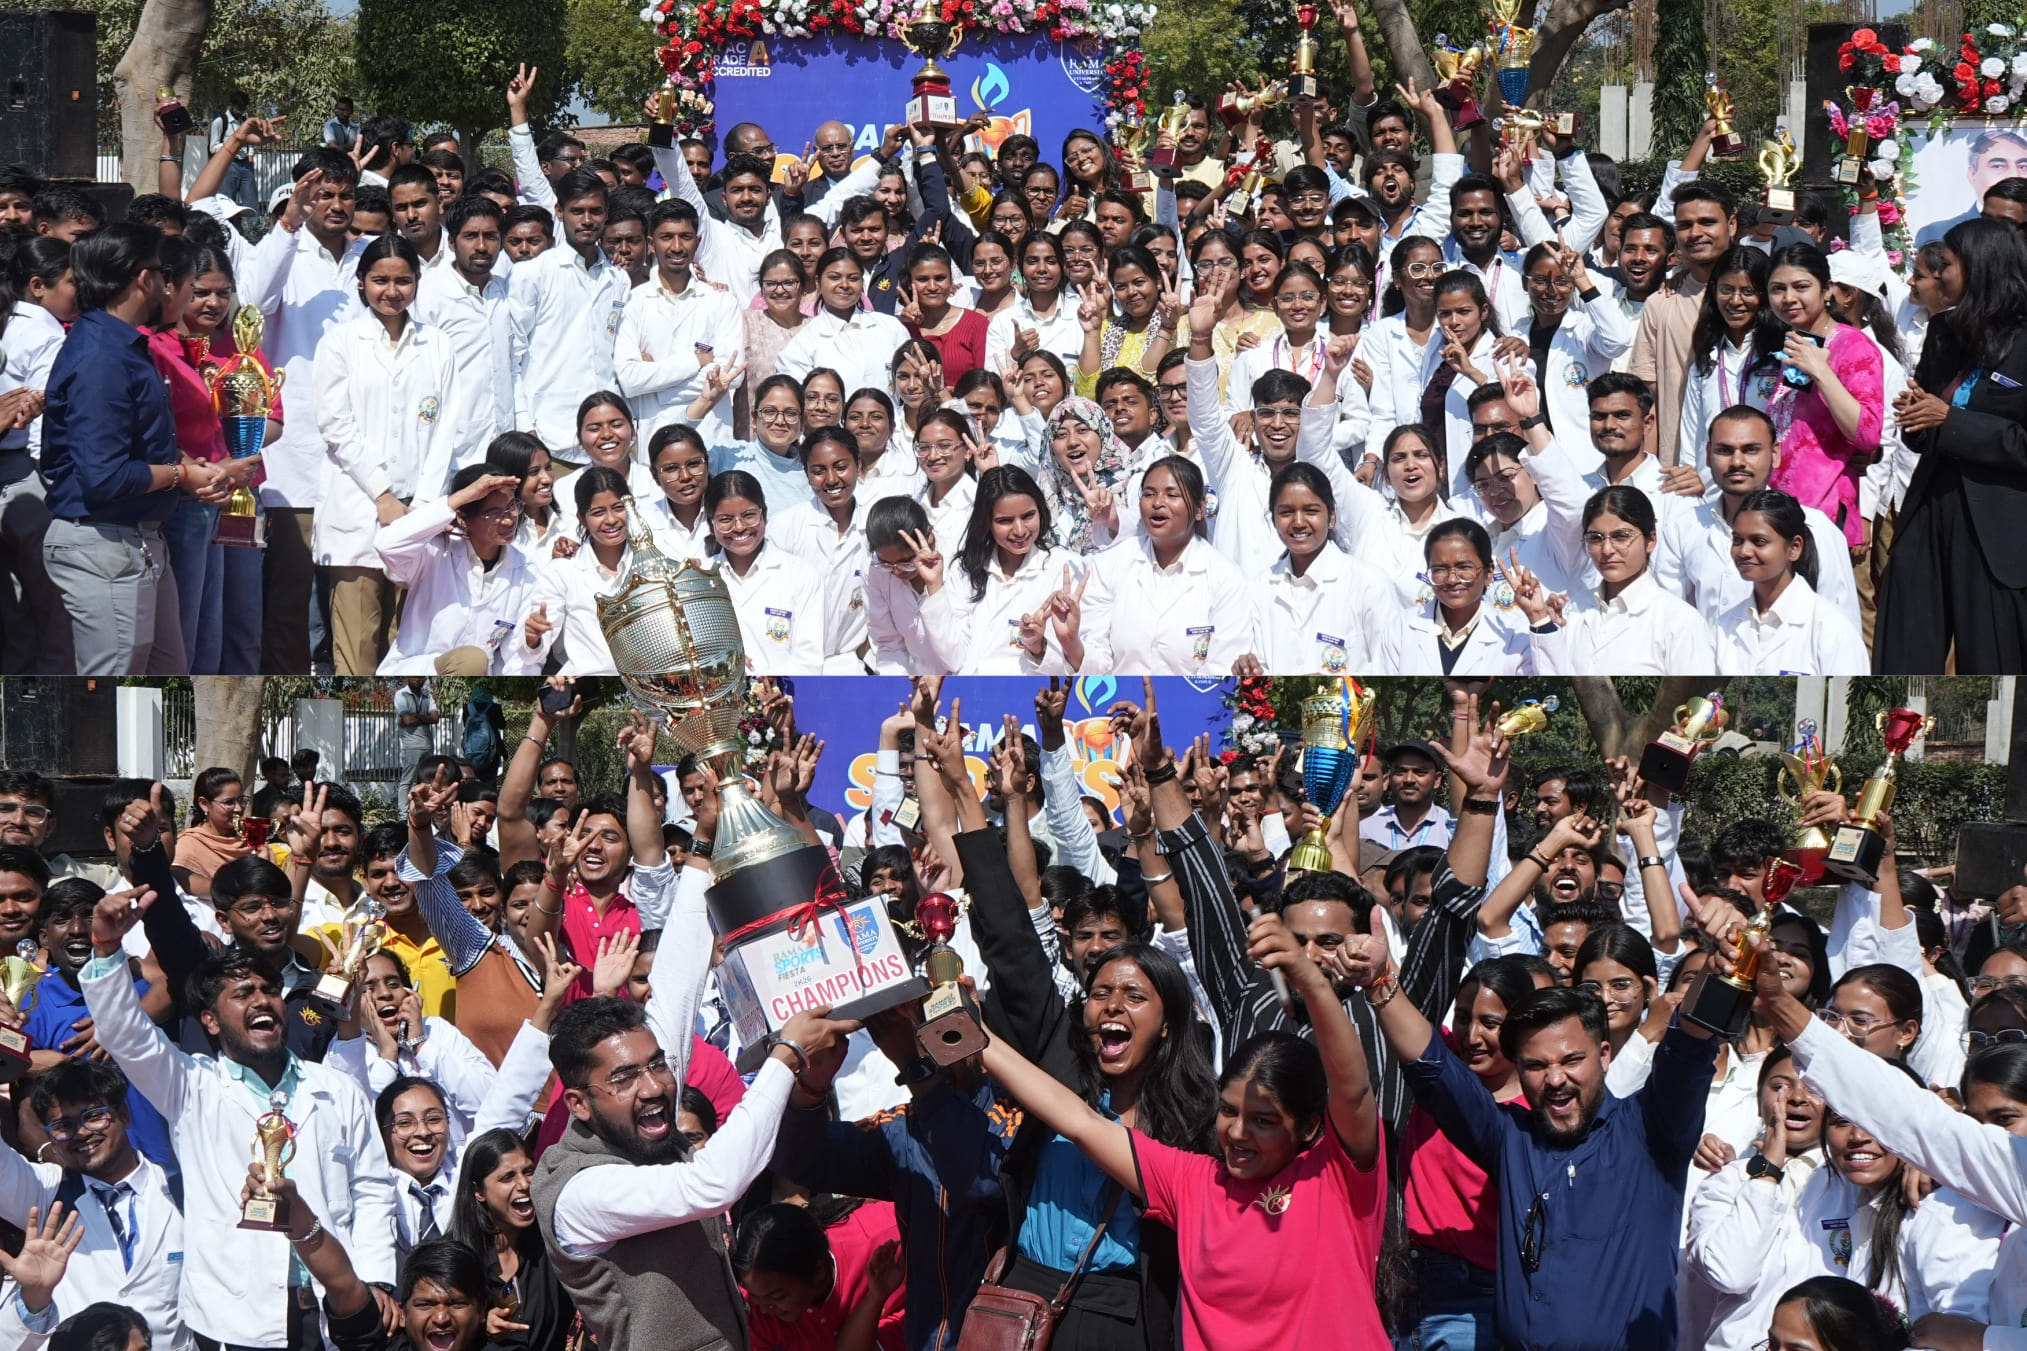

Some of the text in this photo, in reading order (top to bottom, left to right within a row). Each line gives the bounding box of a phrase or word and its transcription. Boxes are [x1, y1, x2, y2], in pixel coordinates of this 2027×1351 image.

[711, 66, 771, 77] CCREDITED
[1069, 58, 1100, 69] RAM
[775, 948, 824, 974] SPORTS
[778, 966, 806, 982] FIESTA
[772, 954, 904, 1021] CHAMPIONS
